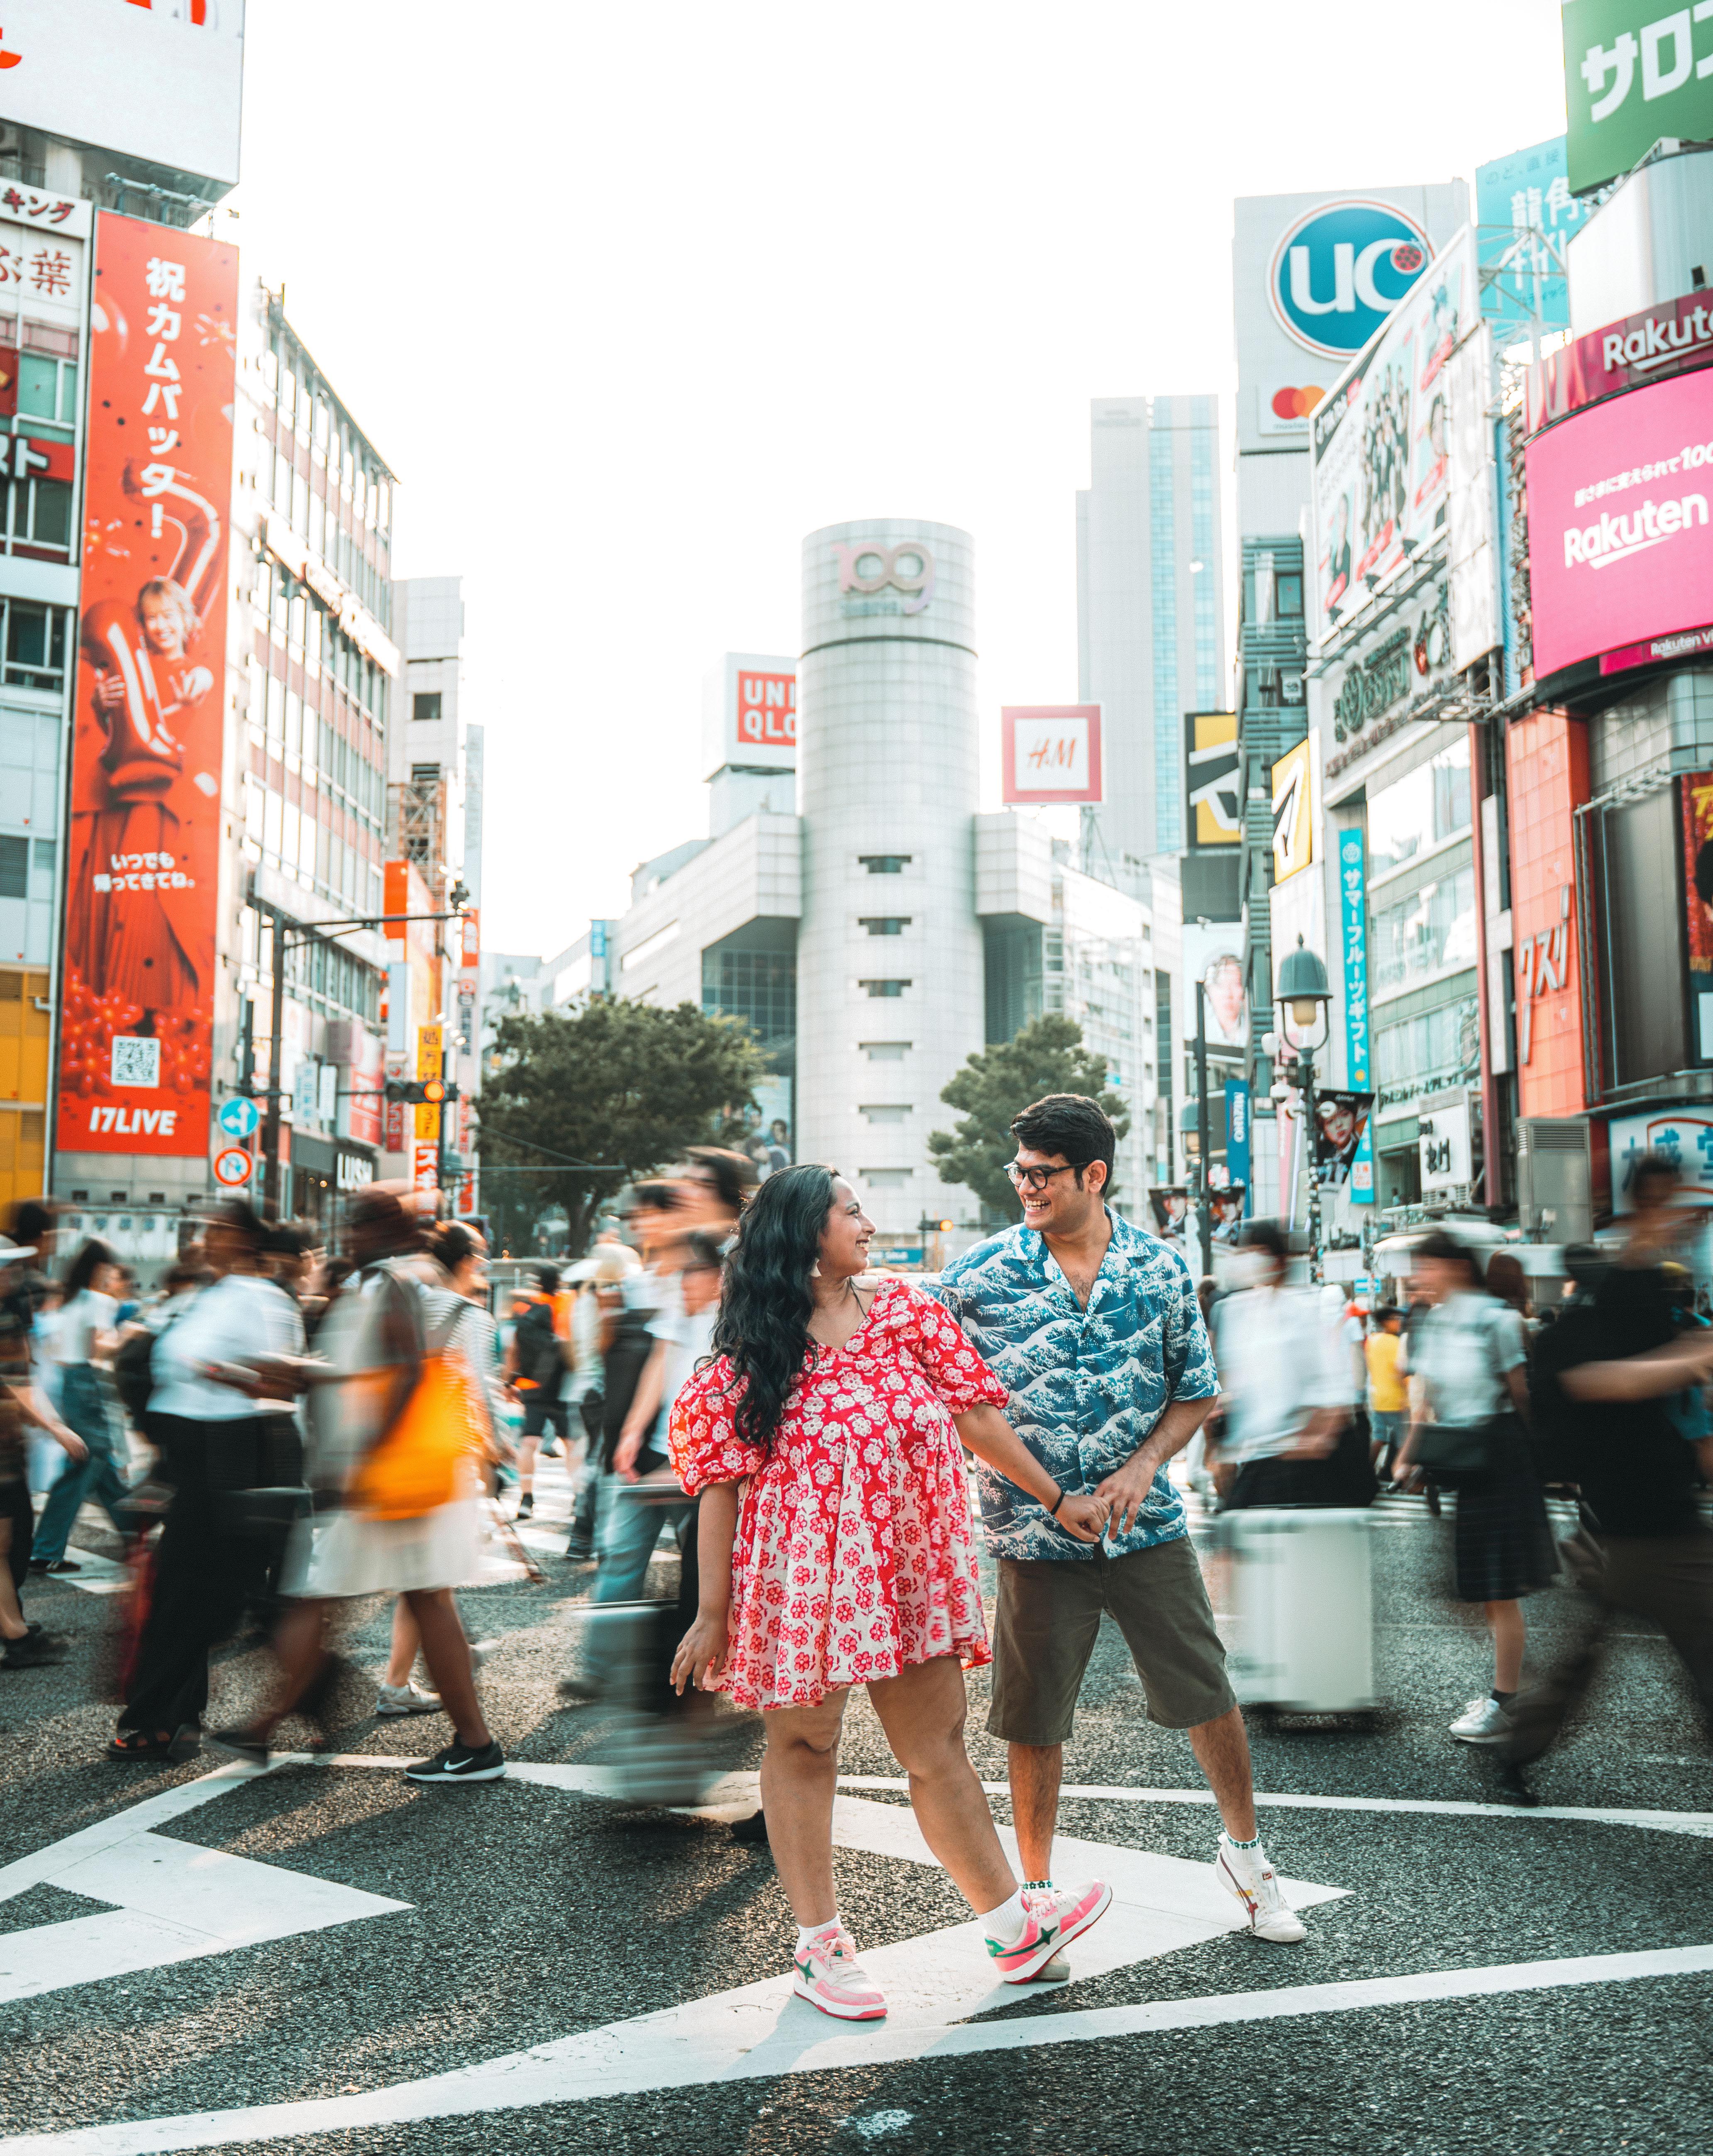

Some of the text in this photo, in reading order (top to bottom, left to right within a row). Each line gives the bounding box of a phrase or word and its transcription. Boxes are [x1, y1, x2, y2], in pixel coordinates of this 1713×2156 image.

[1603, 305, 1713, 371] Rakut
[1564, 494, 1710, 569] Rakuten
[831, 541, 935, 614] 109
[1651, 635, 1701, 657] Rakuten
[93, 872, 195, 893] 帰ってきてね。
[111, 851, 175, 871] いつでも
[1342, 870, 1366, 1063] サマーフルーツギフト
[89, 1106, 177, 1136] 17LIVE
